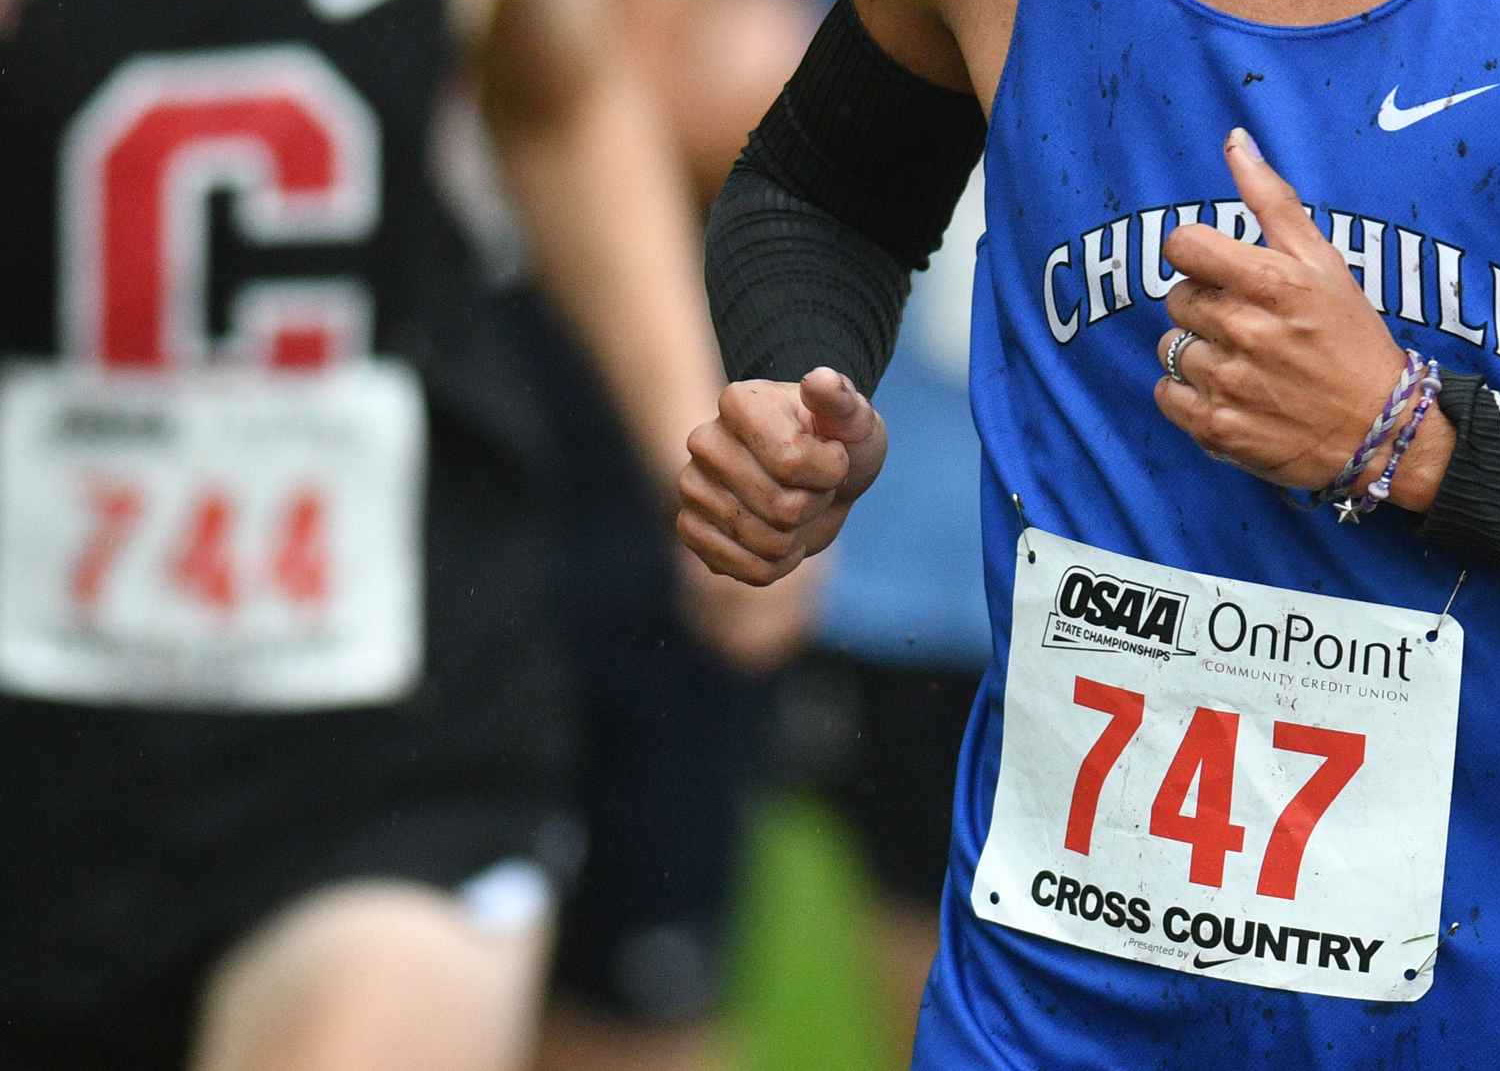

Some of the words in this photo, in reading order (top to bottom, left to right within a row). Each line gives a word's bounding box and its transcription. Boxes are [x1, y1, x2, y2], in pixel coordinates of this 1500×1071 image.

[56, 41, 382, 370] C
[66, 477, 333, 616] 744
[1054, 619, 1082, 638] STATE
[1083, 629, 1171, 662] CHAMPIONSHIPS
[1059, 572, 1182, 645] OSAA
[1208, 601, 1413, 682] OnPoint
[1204, 660, 1295, 686] COMMUNITY
[1301, 677, 1352, 695] CREDIT
[1358, 686, 1410, 703] UNION
[1064, 675, 1367, 901] 747
[1031, 870, 1151, 935] CROSS
[1162, 906, 1386, 974] COUNTRY
[1127, 936, 1173, 957] Presented
[1175, 948, 1190, 960] by
